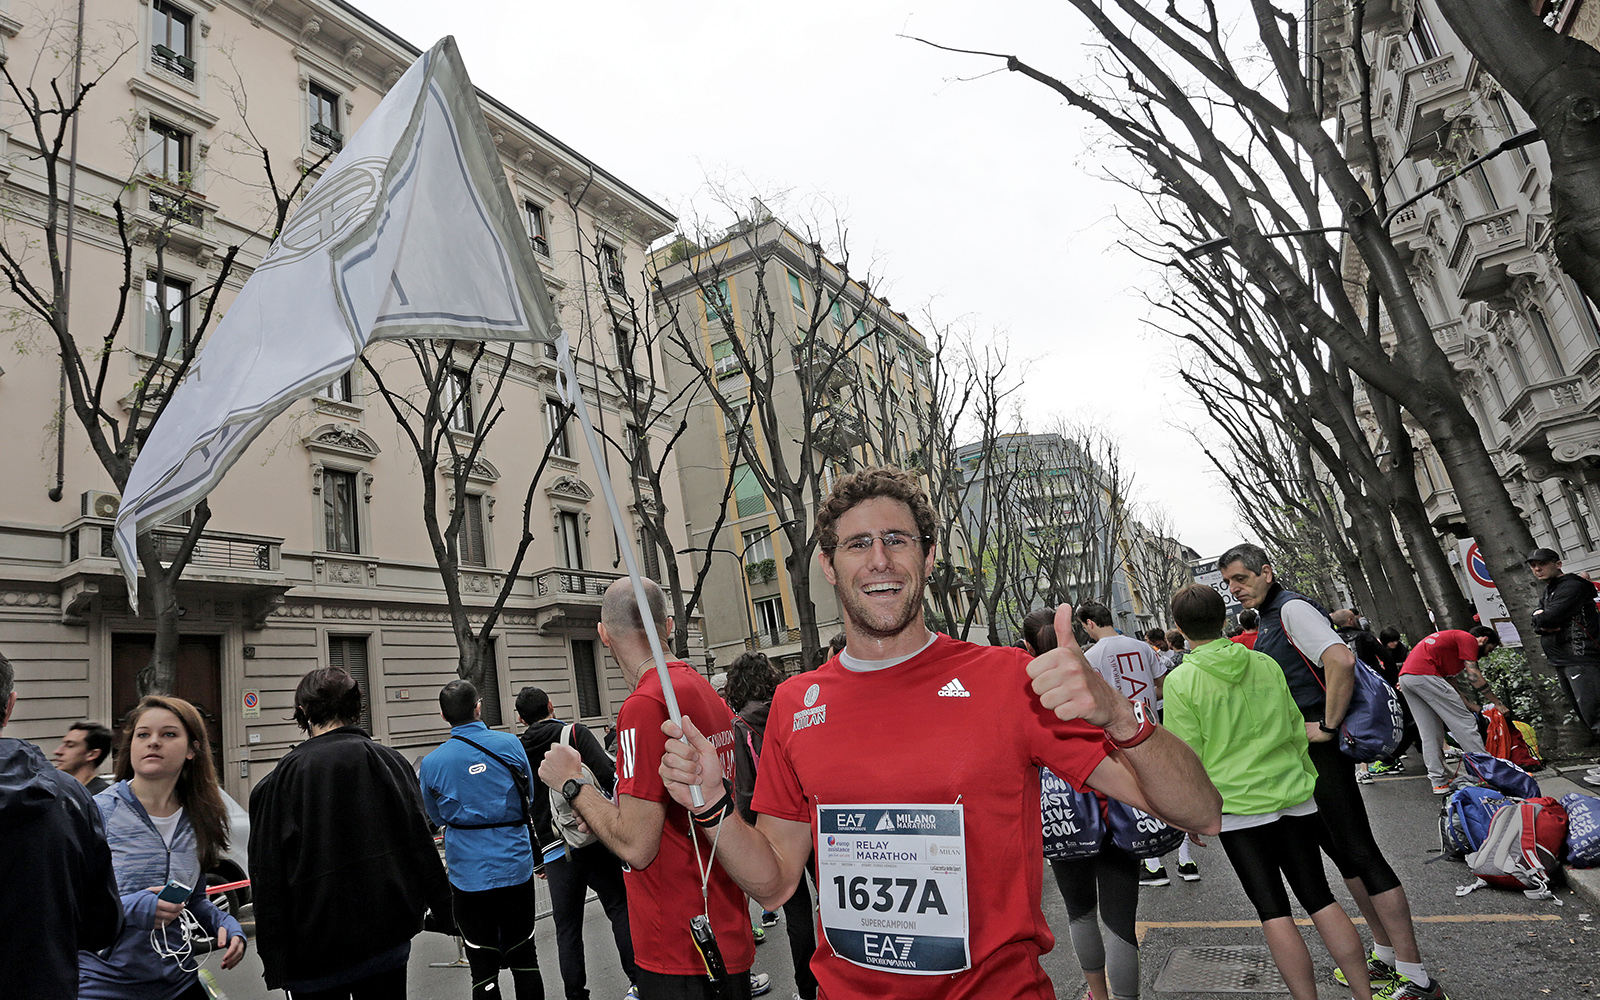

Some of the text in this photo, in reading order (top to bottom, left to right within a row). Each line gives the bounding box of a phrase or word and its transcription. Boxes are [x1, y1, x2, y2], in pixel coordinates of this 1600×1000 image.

[1116, 652, 1151, 707] EA
[937, 689, 971, 698] adidas
[792, 711, 826, 732] MILAN
[1041, 777, 1066, 793] RUN
[837, 813, 866, 827] EA7
[896, 813, 937, 825] MILANO
[1041, 806, 1075, 825] LIVE
[1042, 820, 1081, 838] COOL
[1136, 818, 1167, 834] COO
[1571, 823, 1599, 840] COOL
[856, 840, 889, 850] RELAY
[856, 851, 918, 861] MARATHON
[833, 875, 949, 916] 1637A
[861, 918, 917, 930] SUPERCAMPIONI
[863, 933, 915, 960] EA7
